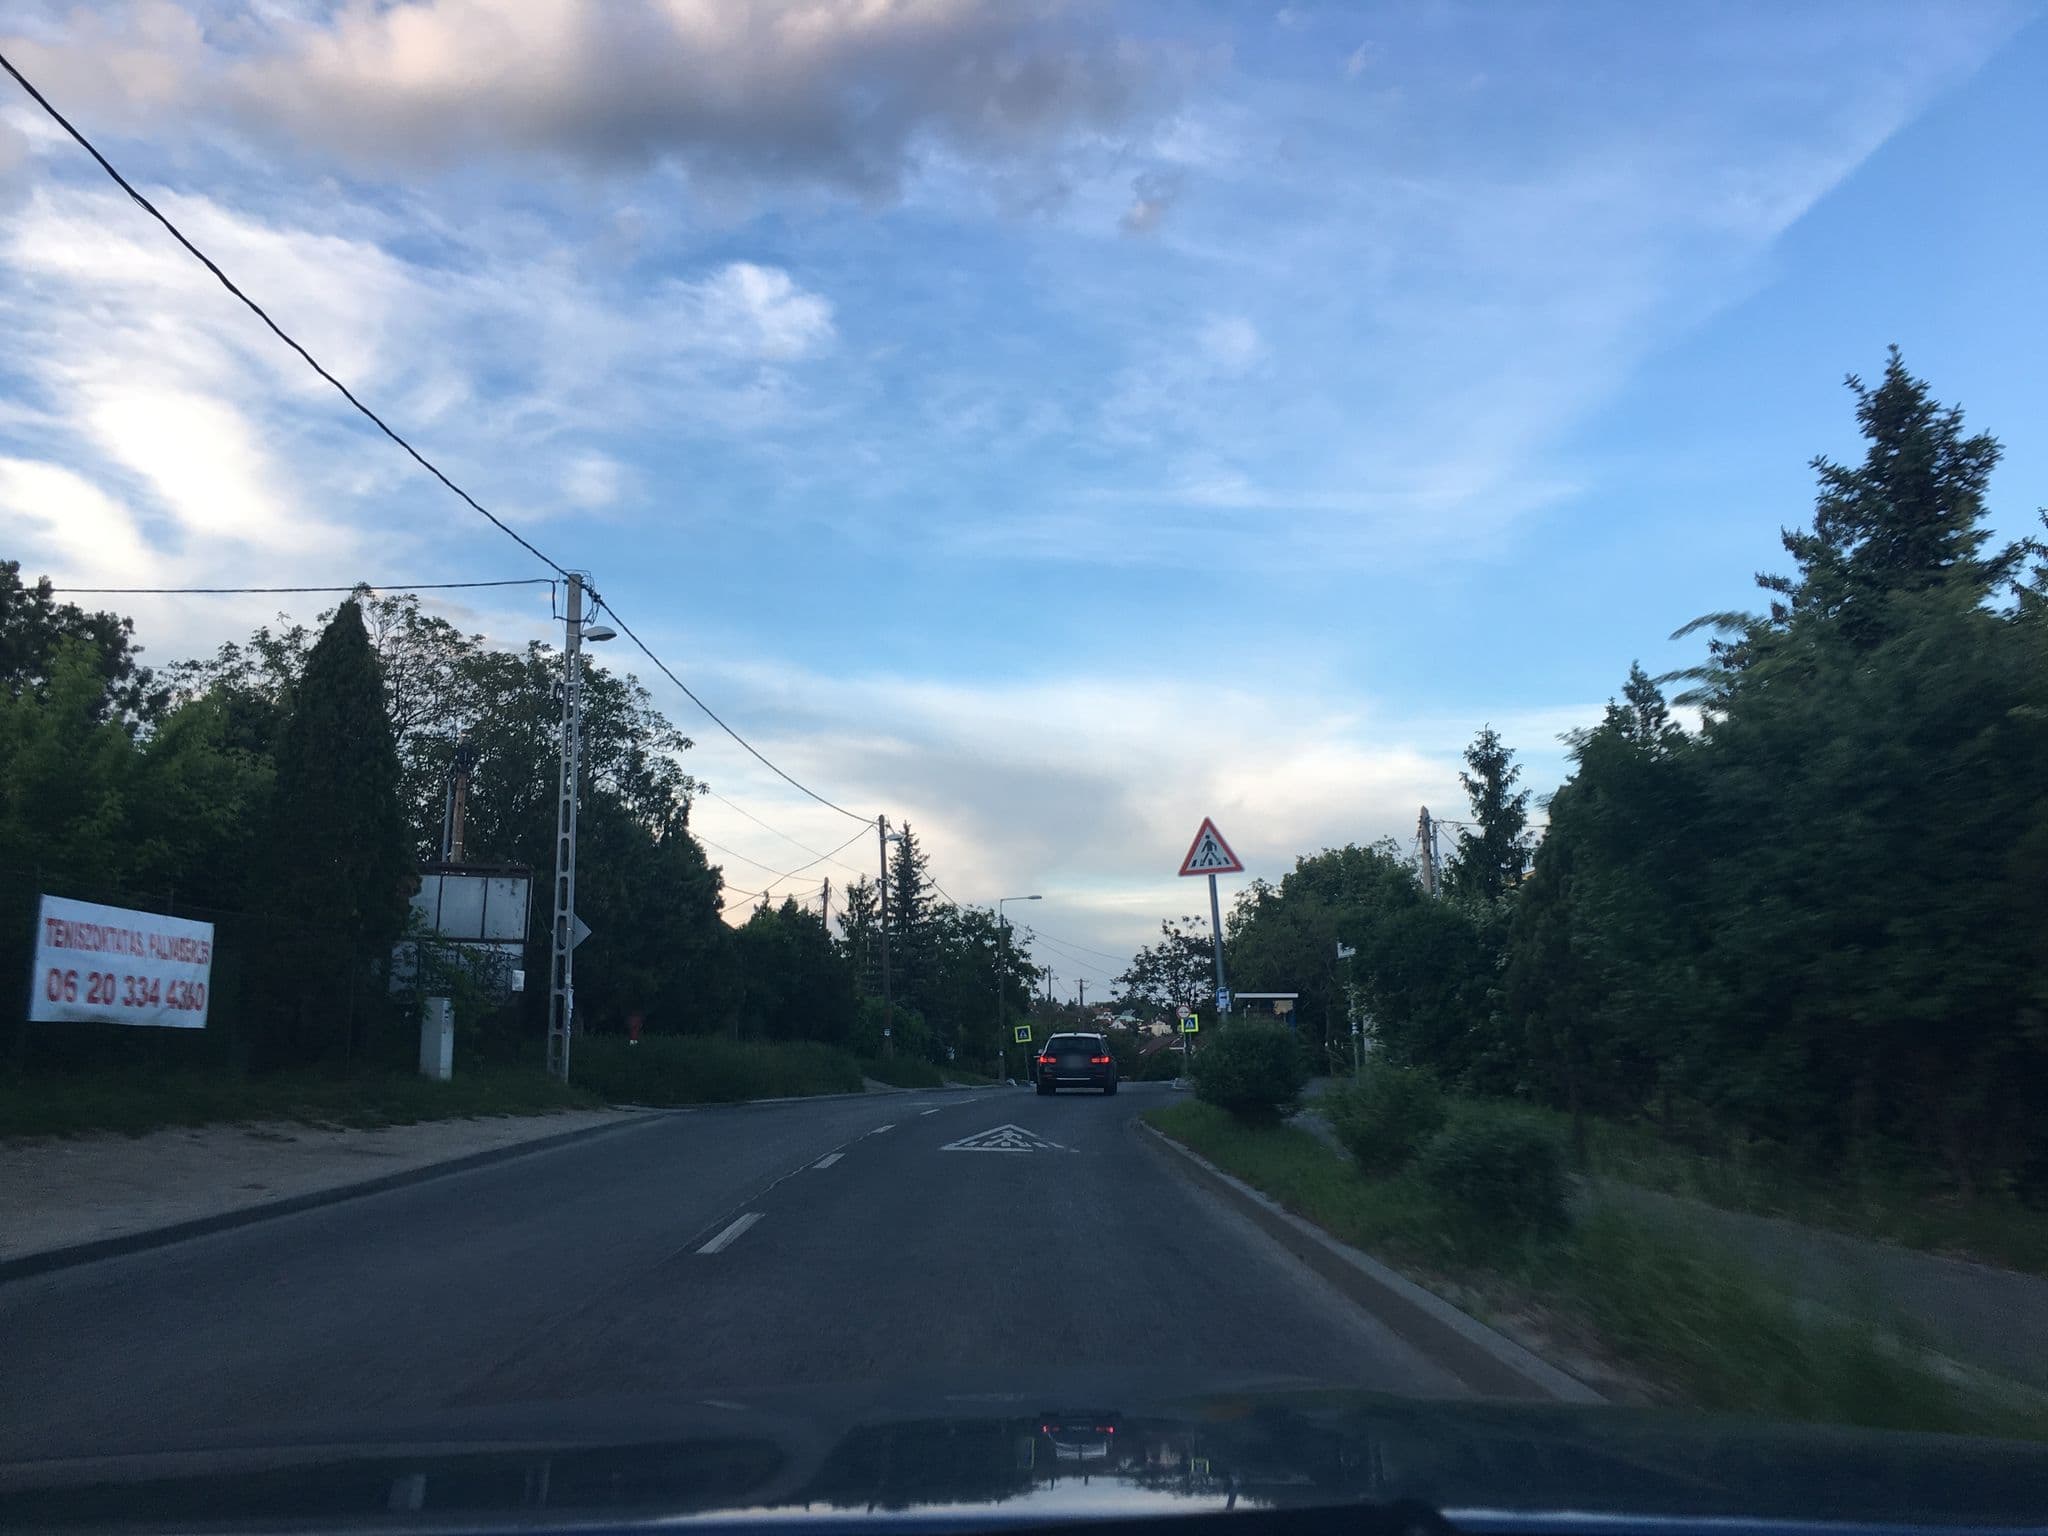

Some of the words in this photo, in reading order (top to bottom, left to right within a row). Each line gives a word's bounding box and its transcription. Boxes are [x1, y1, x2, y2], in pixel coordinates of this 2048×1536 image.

[47, 968, 78, 1002] 06
[86, 971, 116, 1005] 20
[122, 975, 161, 1008] 334
